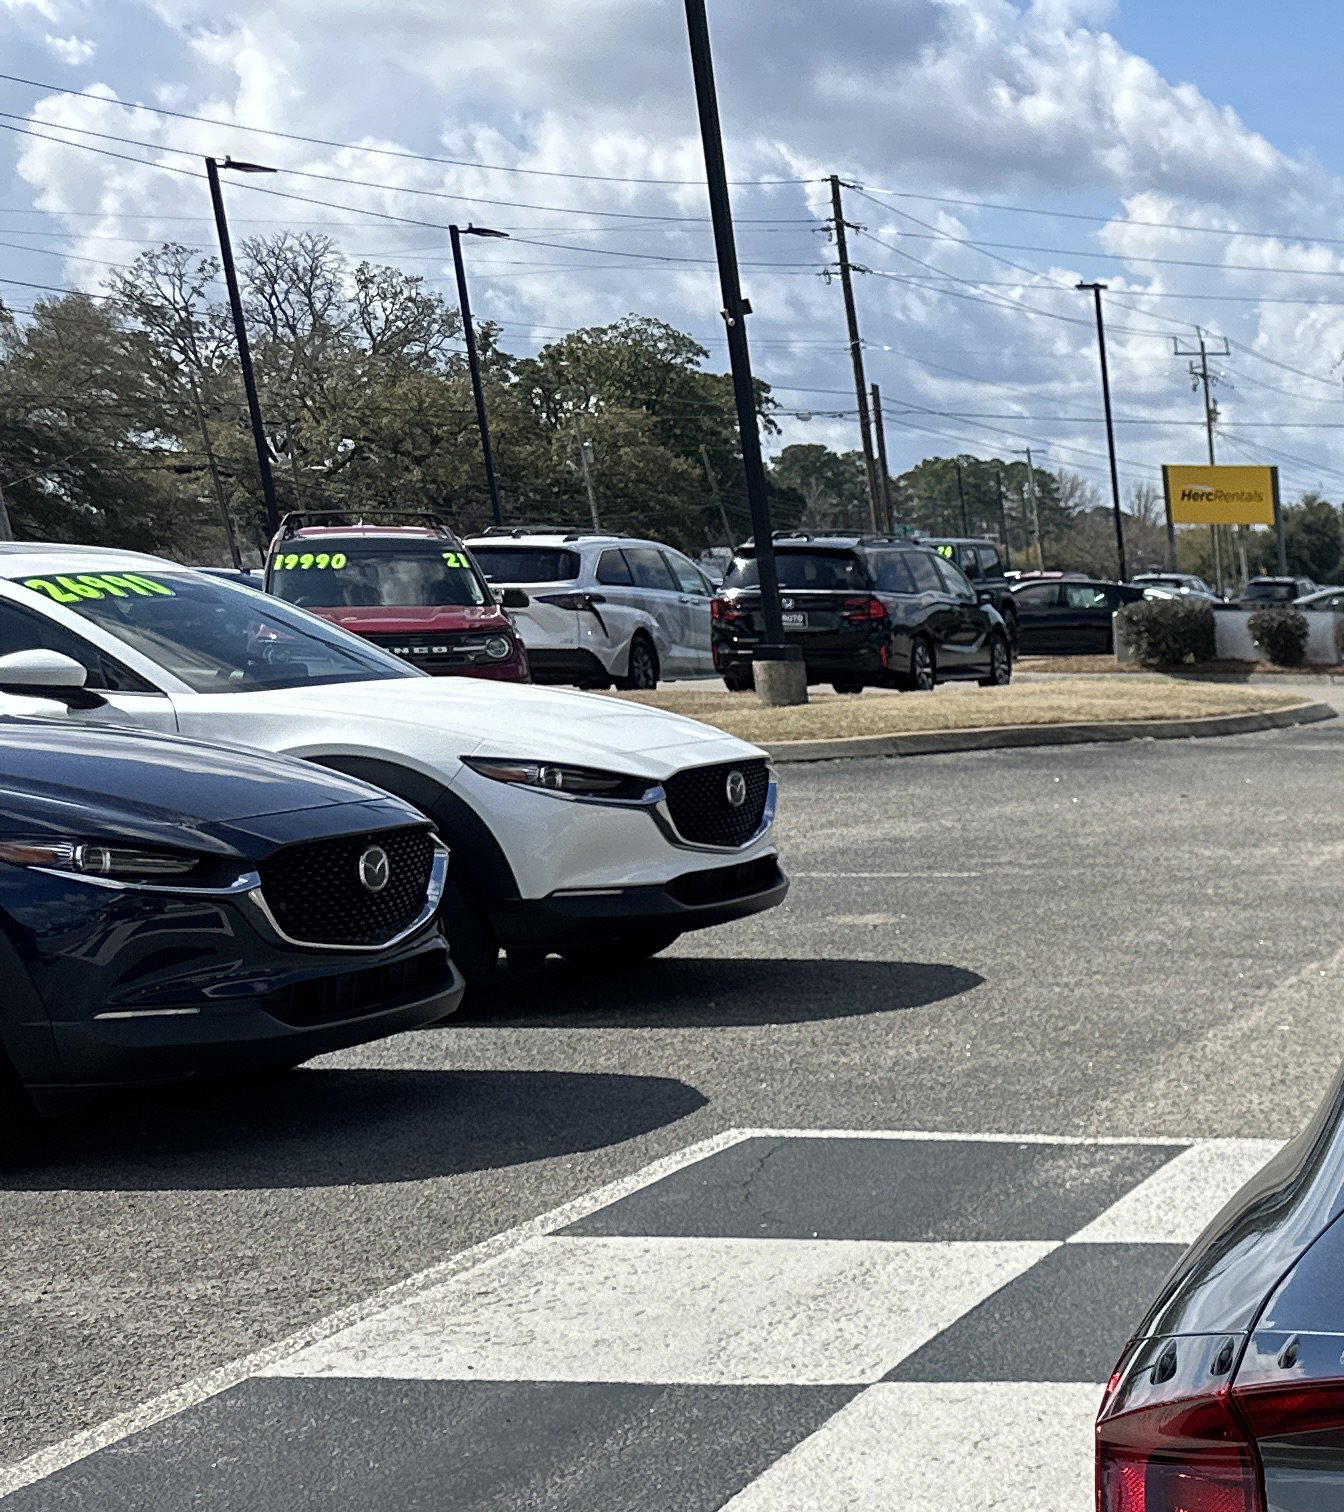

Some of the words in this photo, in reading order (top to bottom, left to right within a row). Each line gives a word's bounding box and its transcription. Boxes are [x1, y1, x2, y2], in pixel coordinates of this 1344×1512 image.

[273, 553, 347, 571] 19990
[442, 552, 471, 569] 21
[24, 573, 177, 603] 26990
